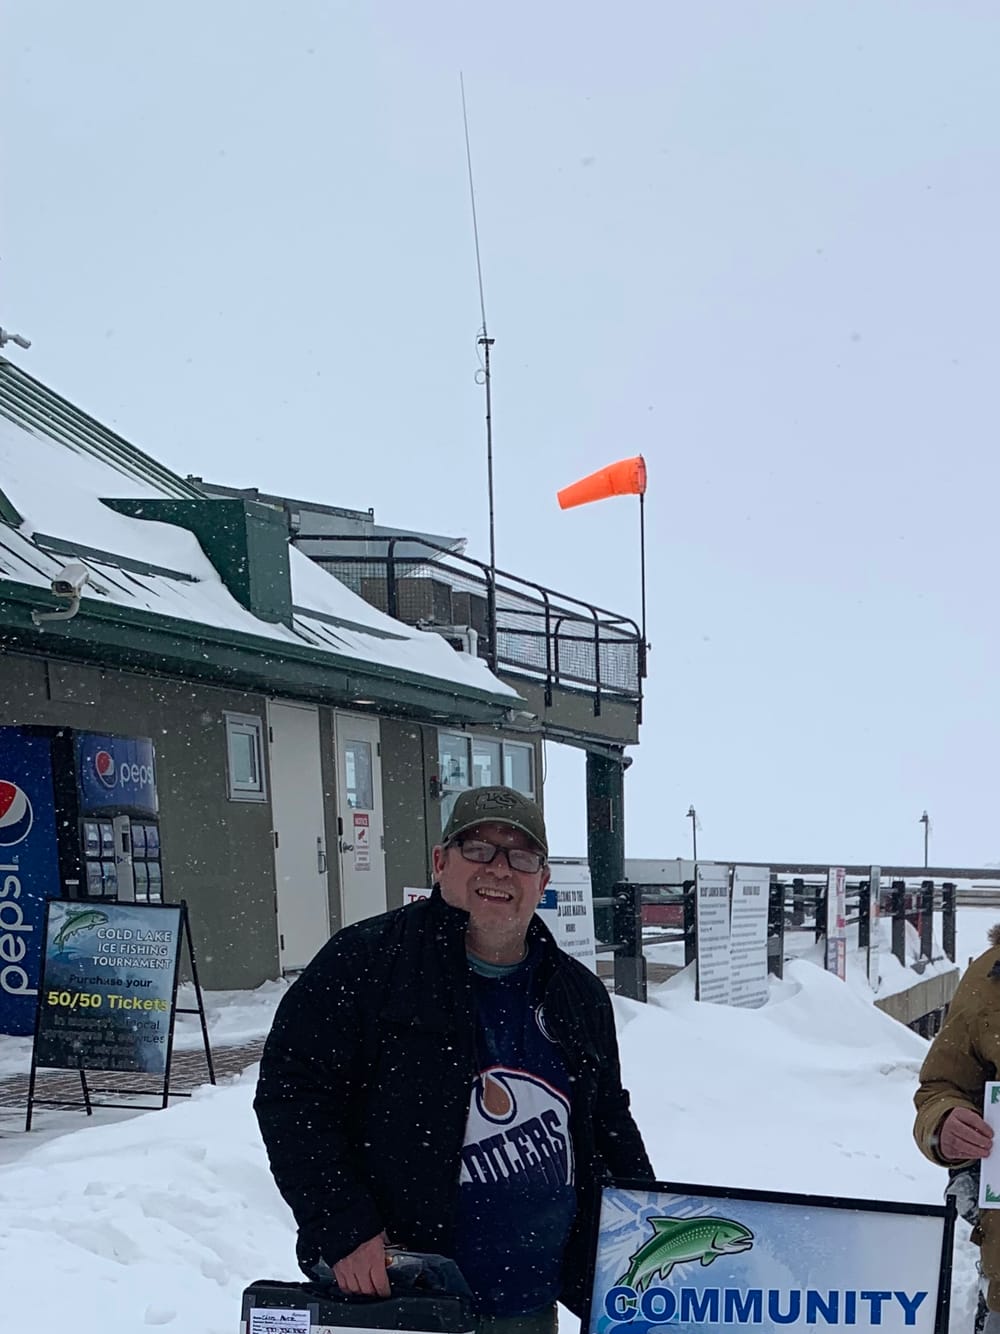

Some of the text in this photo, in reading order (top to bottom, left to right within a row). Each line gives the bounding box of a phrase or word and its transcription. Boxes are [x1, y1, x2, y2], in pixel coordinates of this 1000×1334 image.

[120, 763, 153, 789] peps
[97, 927, 172, 942] COLD LAKE
[98, 943, 168, 956] ICE FISHING
[92, 956, 172, 969] TOURNAMENT
[126, 978, 153, 989] your
[47, 991, 169, 1012] 50/50 Tickets
[603, 1285, 929, 1326] COMMUNITY
